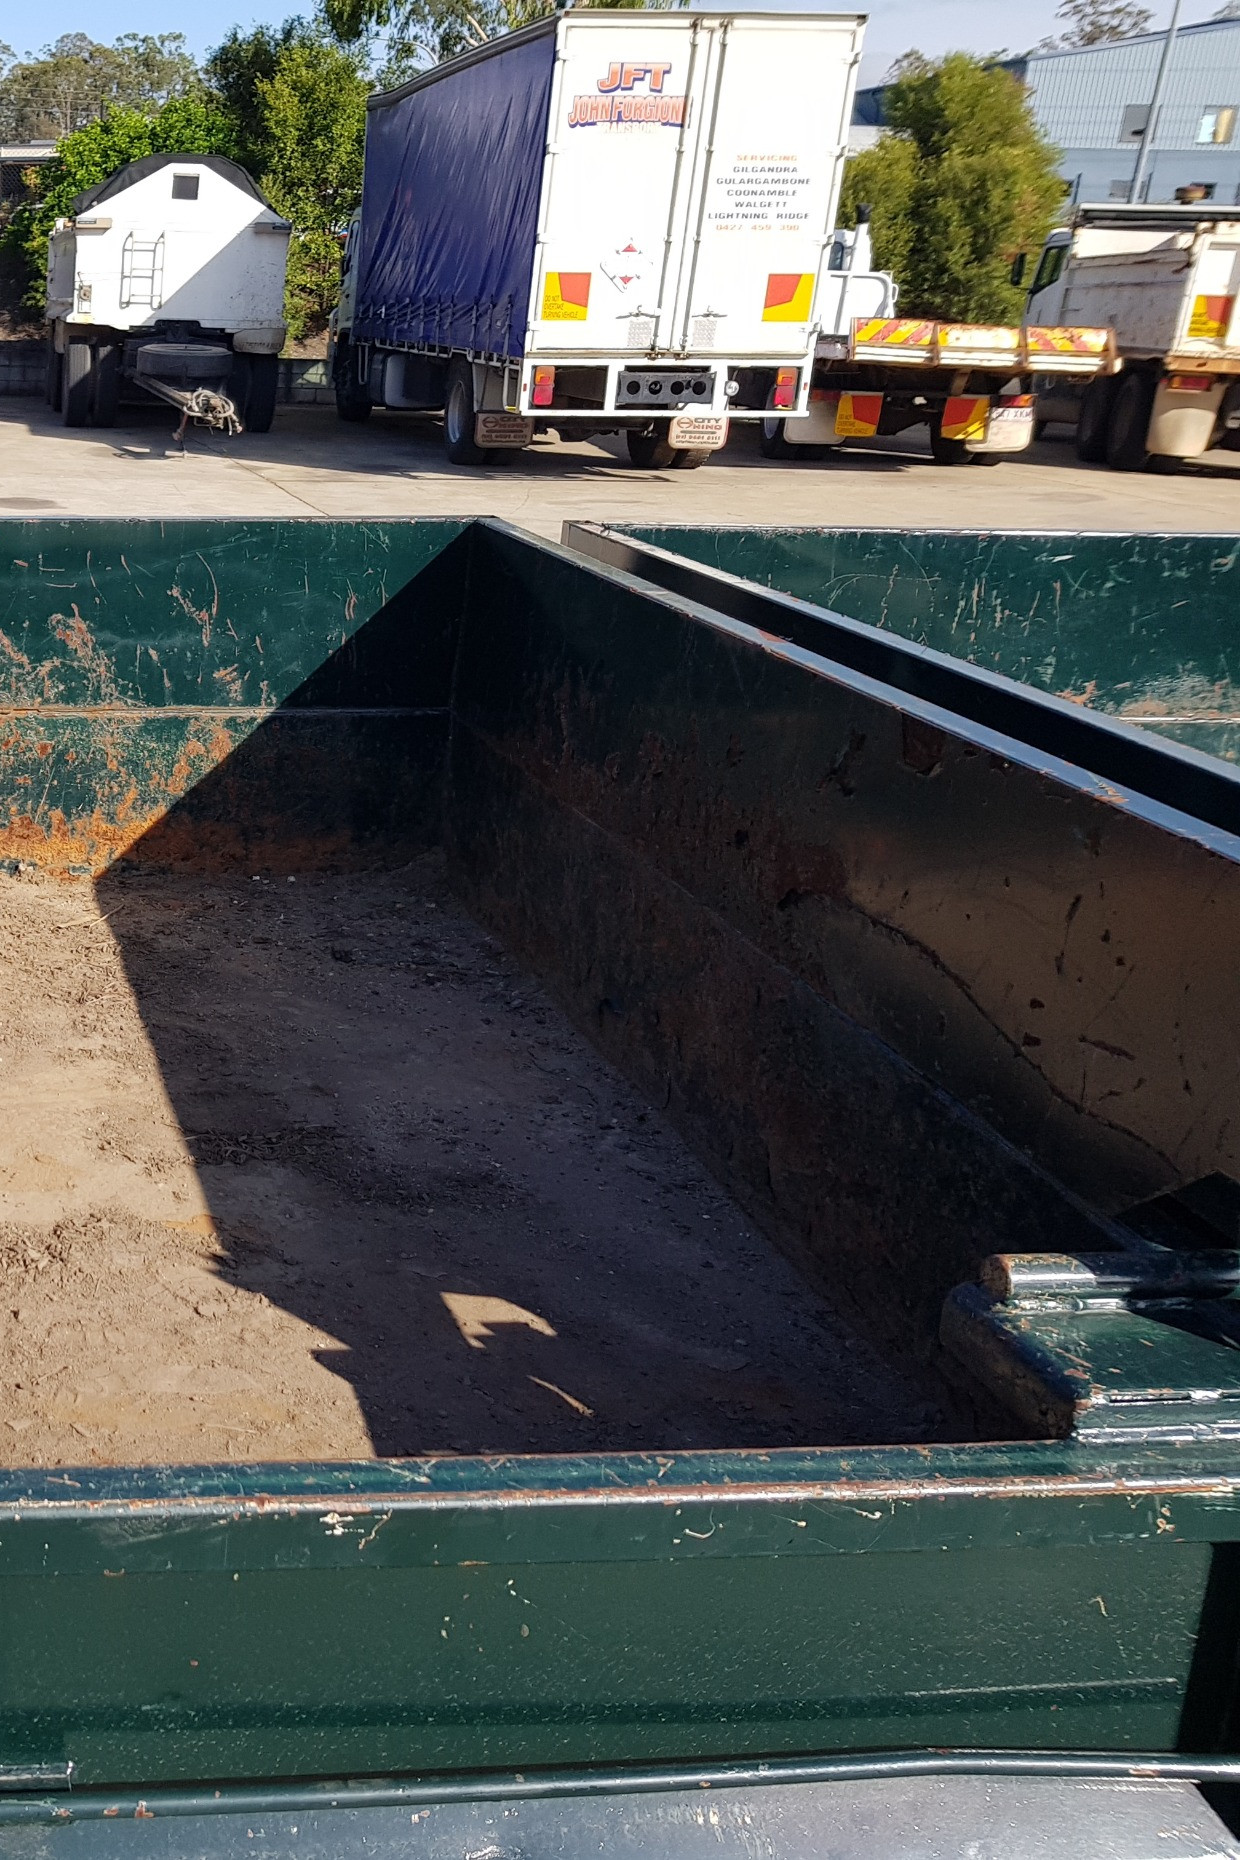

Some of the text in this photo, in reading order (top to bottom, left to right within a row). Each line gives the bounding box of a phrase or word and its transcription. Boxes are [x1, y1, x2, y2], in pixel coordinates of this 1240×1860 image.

[597, 62, 672, 93] JFT
[568, 95, 693, 129] JOHN FORGION
[737, 154, 798, 162] SERVICING
[708, 212, 811, 220] LIGHTNING RIDGE
